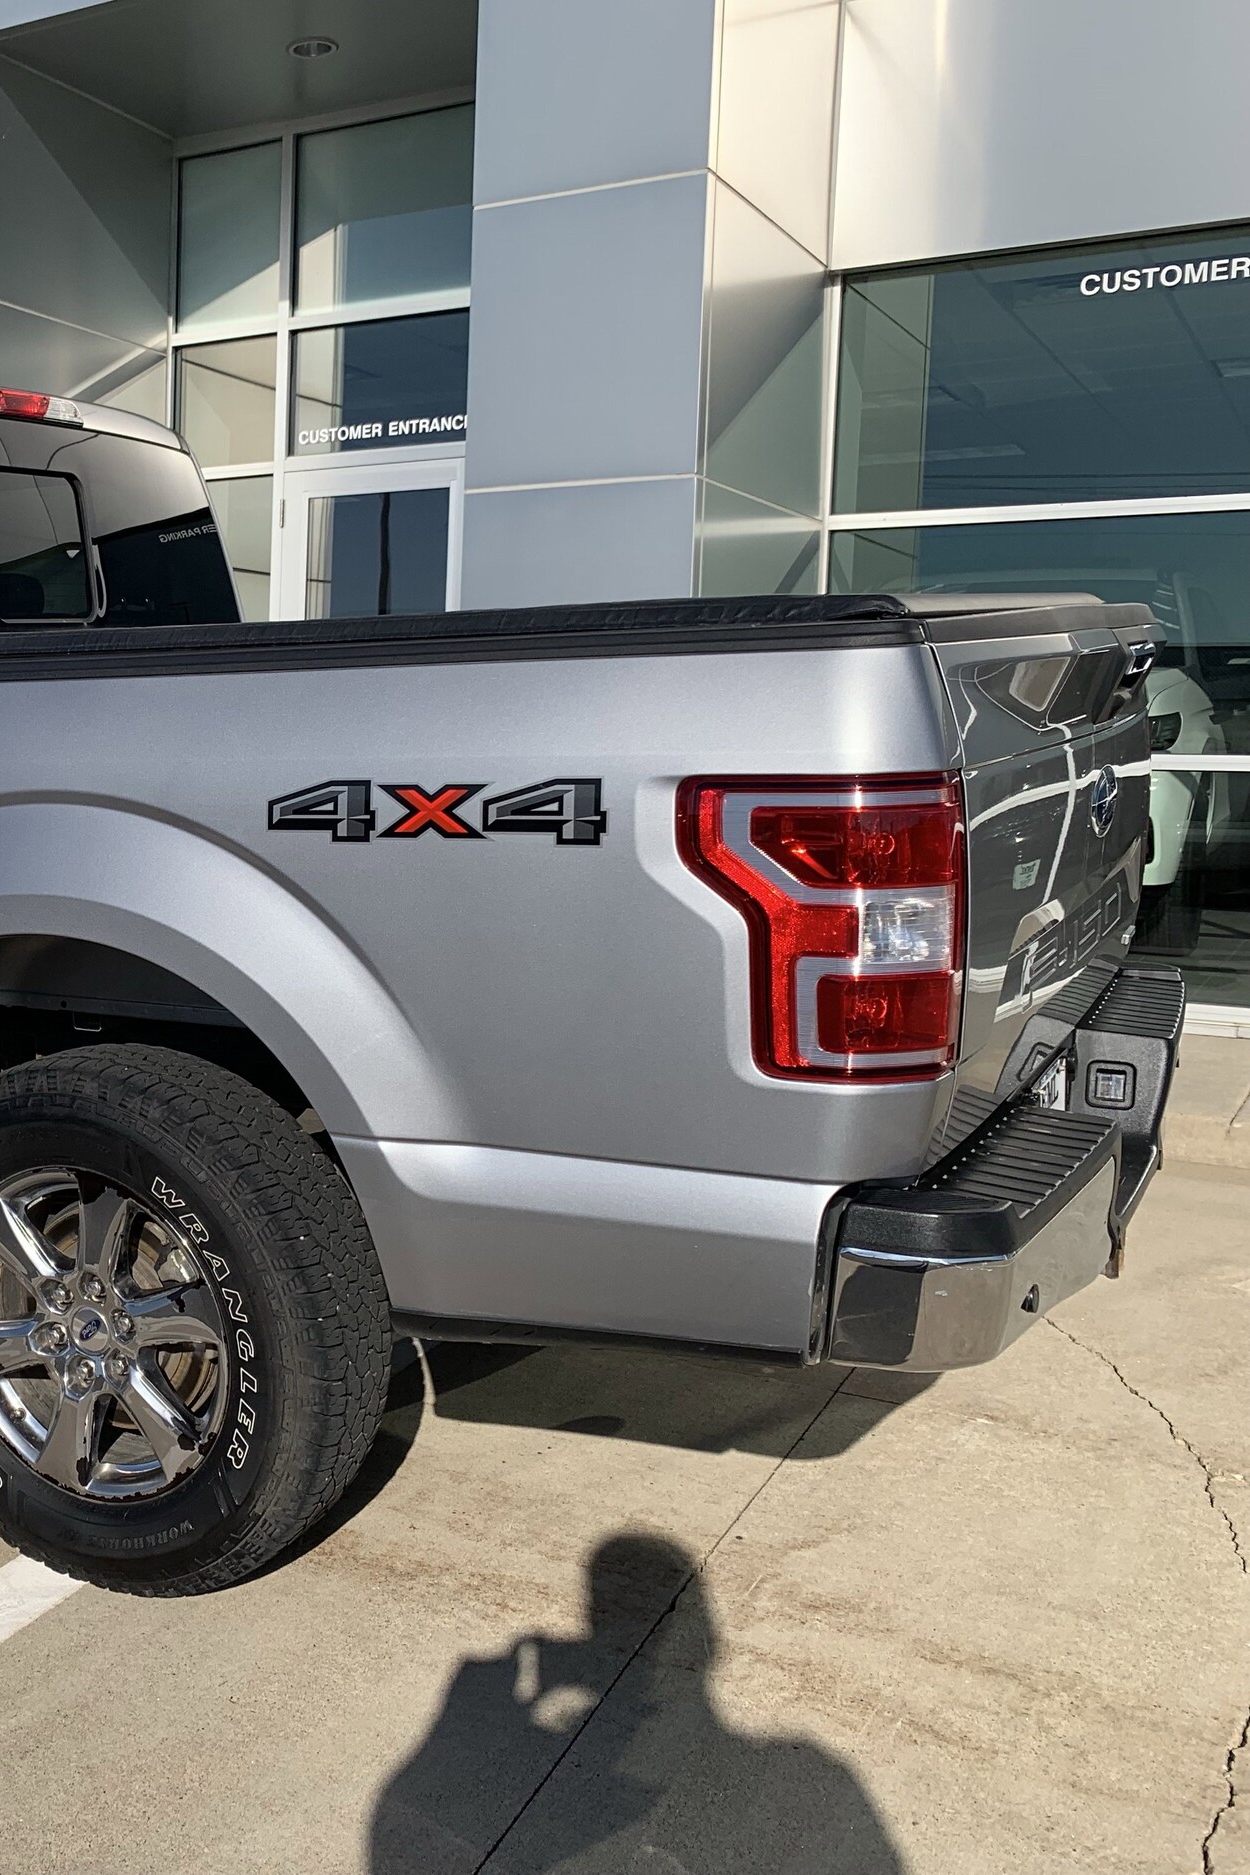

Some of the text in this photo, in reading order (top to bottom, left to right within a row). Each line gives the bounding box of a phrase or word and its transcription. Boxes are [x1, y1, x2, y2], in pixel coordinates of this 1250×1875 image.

[1080, 257, 1250, 296] CUSTOMER
[298, 415, 468, 445] CUSTOMER ENTRANC
[151, 1176, 258, 1469] WRANGLER
